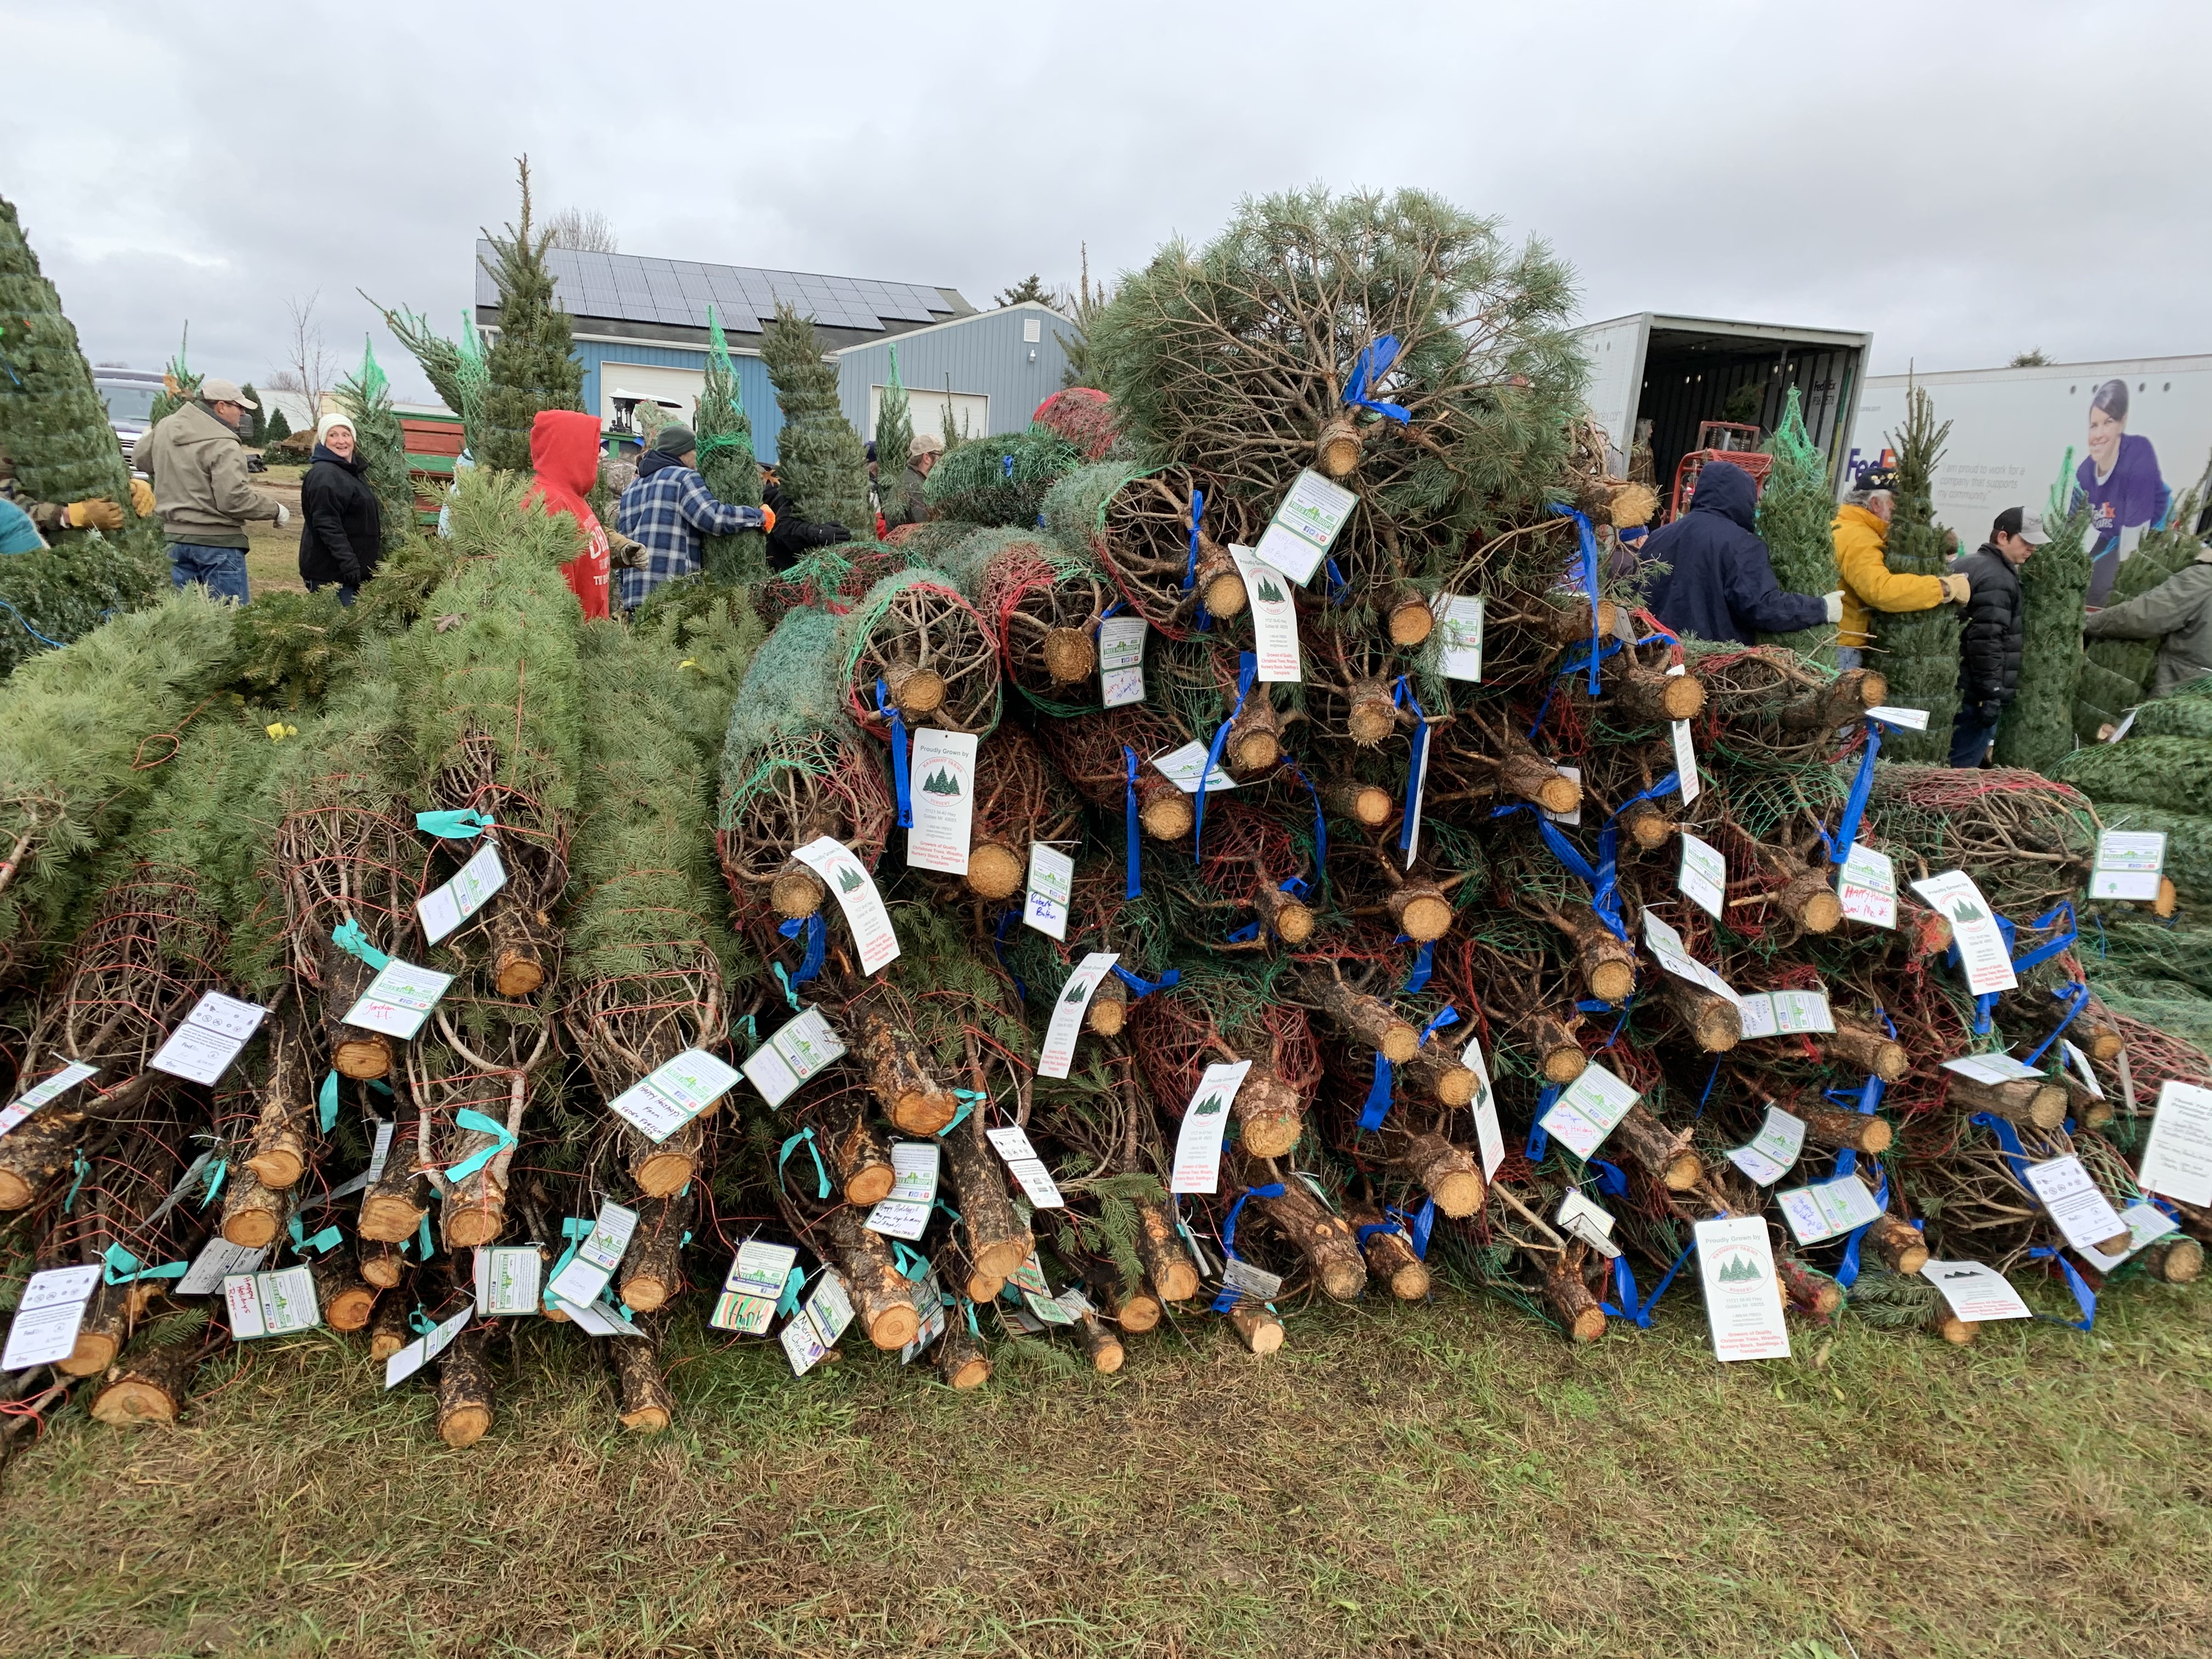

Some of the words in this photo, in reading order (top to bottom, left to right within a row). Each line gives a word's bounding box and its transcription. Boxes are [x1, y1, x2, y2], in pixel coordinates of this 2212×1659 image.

[1958, 464, 1978, 475] proud
[1980, 465, 1987, 473] to
[1989, 465, 2006, 475] work
[2008, 465, 2018, 476] for
[2020, 467, 2025, 476] a
[1940, 477, 1968, 488] company
[1972, 477, 1985, 487] that
[1987, 479, 2018, 490] supports
[1938, 489, 1948, 500] my
[1290, 501, 1305, 514] TREES
[1305, 507, 1314, 519] FOR
[1314, 514, 1334, 531] TROOPS
[1104, 647, 1116, 655] TREES
[1124, 644, 1139, 652] TROOPS
[920, 745, 941, 754] Proudly
[380, 983, 398, 991] TREES
[410, 990, 433, 999] TROOPS
[363, 1002, 397, 1015] Jordan
[787, 1029, 798, 1044] TREES
[797, 1041, 805, 1051] FOR
[803, 1048, 818, 1067] TROOPS
[667, 1069, 681, 1081] TREES
[680, 1077, 690, 1087] FOR
[689, 1082, 708, 1099] TROOPS
[1578, 1086, 1591, 1099] TREES
[1591, 1094, 1599, 1105] FOR
[1599, 1101, 1617, 1118] TROOPS
[761, 1277, 781, 1285] TROOPS
[271, 1278, 279, 1296] TREES
[278, 1306, 286, 1327] TROOPS
[815, 1295, 825, 1311] TREES
[822, 1306, 831, 1318] FOR
[828, 1316, 840, 1334] TROOPS
[798, 1315, 812, 1344] Merry
